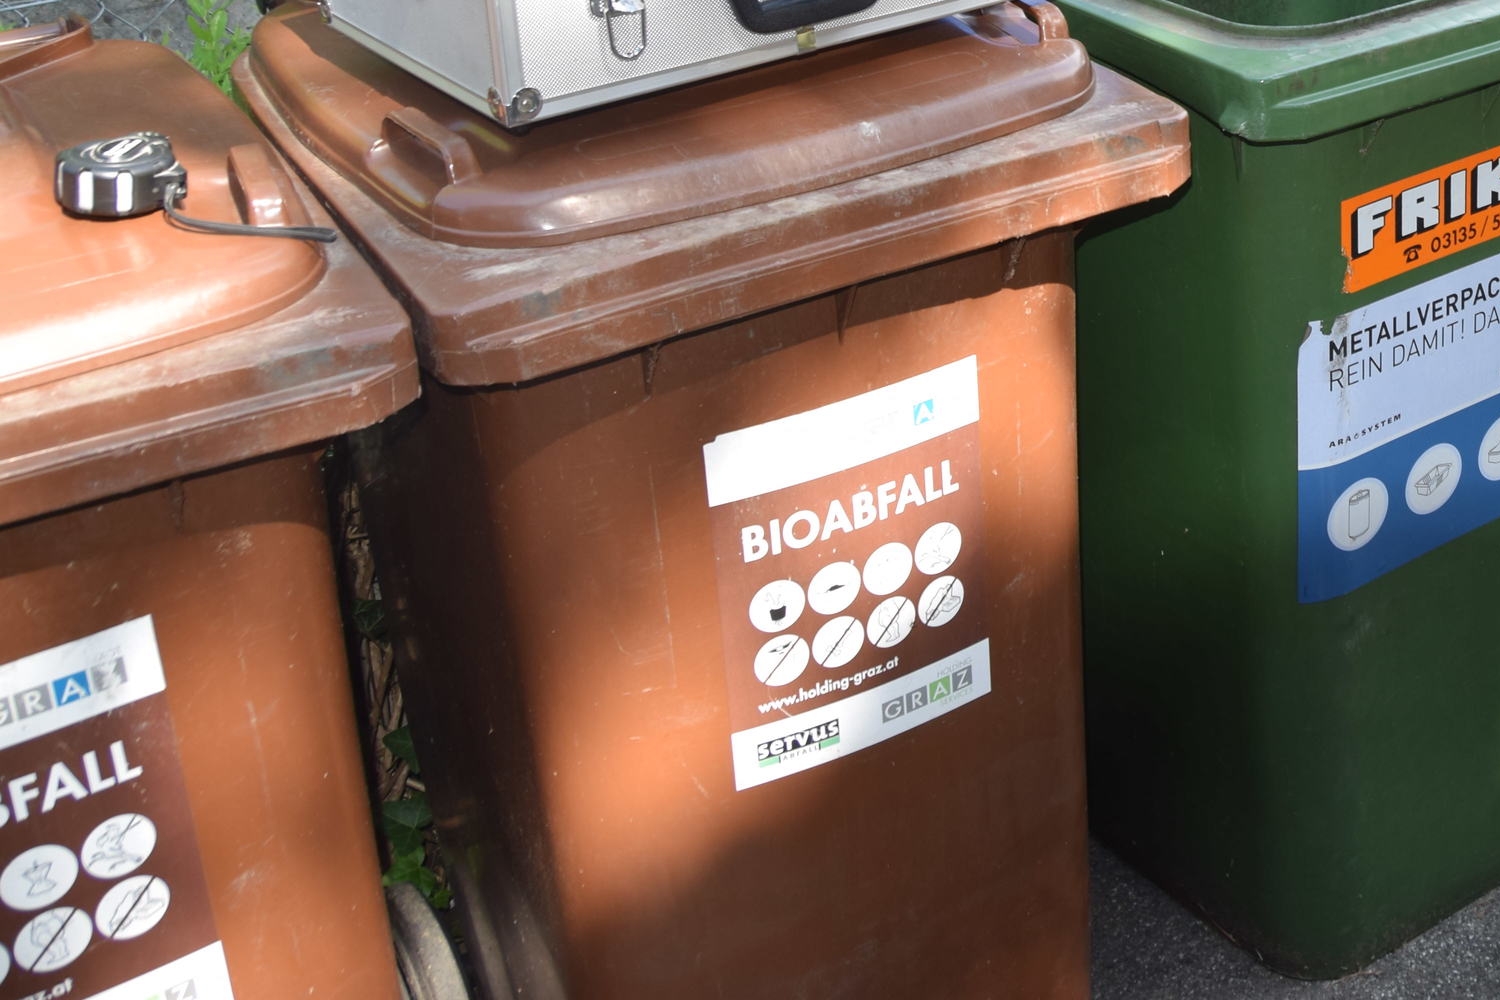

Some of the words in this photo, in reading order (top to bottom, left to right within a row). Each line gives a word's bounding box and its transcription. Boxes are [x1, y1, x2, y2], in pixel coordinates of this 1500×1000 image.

[1329, 351, 1383, 392] REIN
[1392, 318, 1465, 368] DAMIT!
[1361, 413, 1401, 436] SYSTEM
[742, 460, 960, 564] BIOABFALL
[758, 656, 899, 715] www.holding-graz.at
[883, 667, 971, 721] GRAZ
[758, 719, 839, 761] servus
[0, 740, 143, 828] FALL
